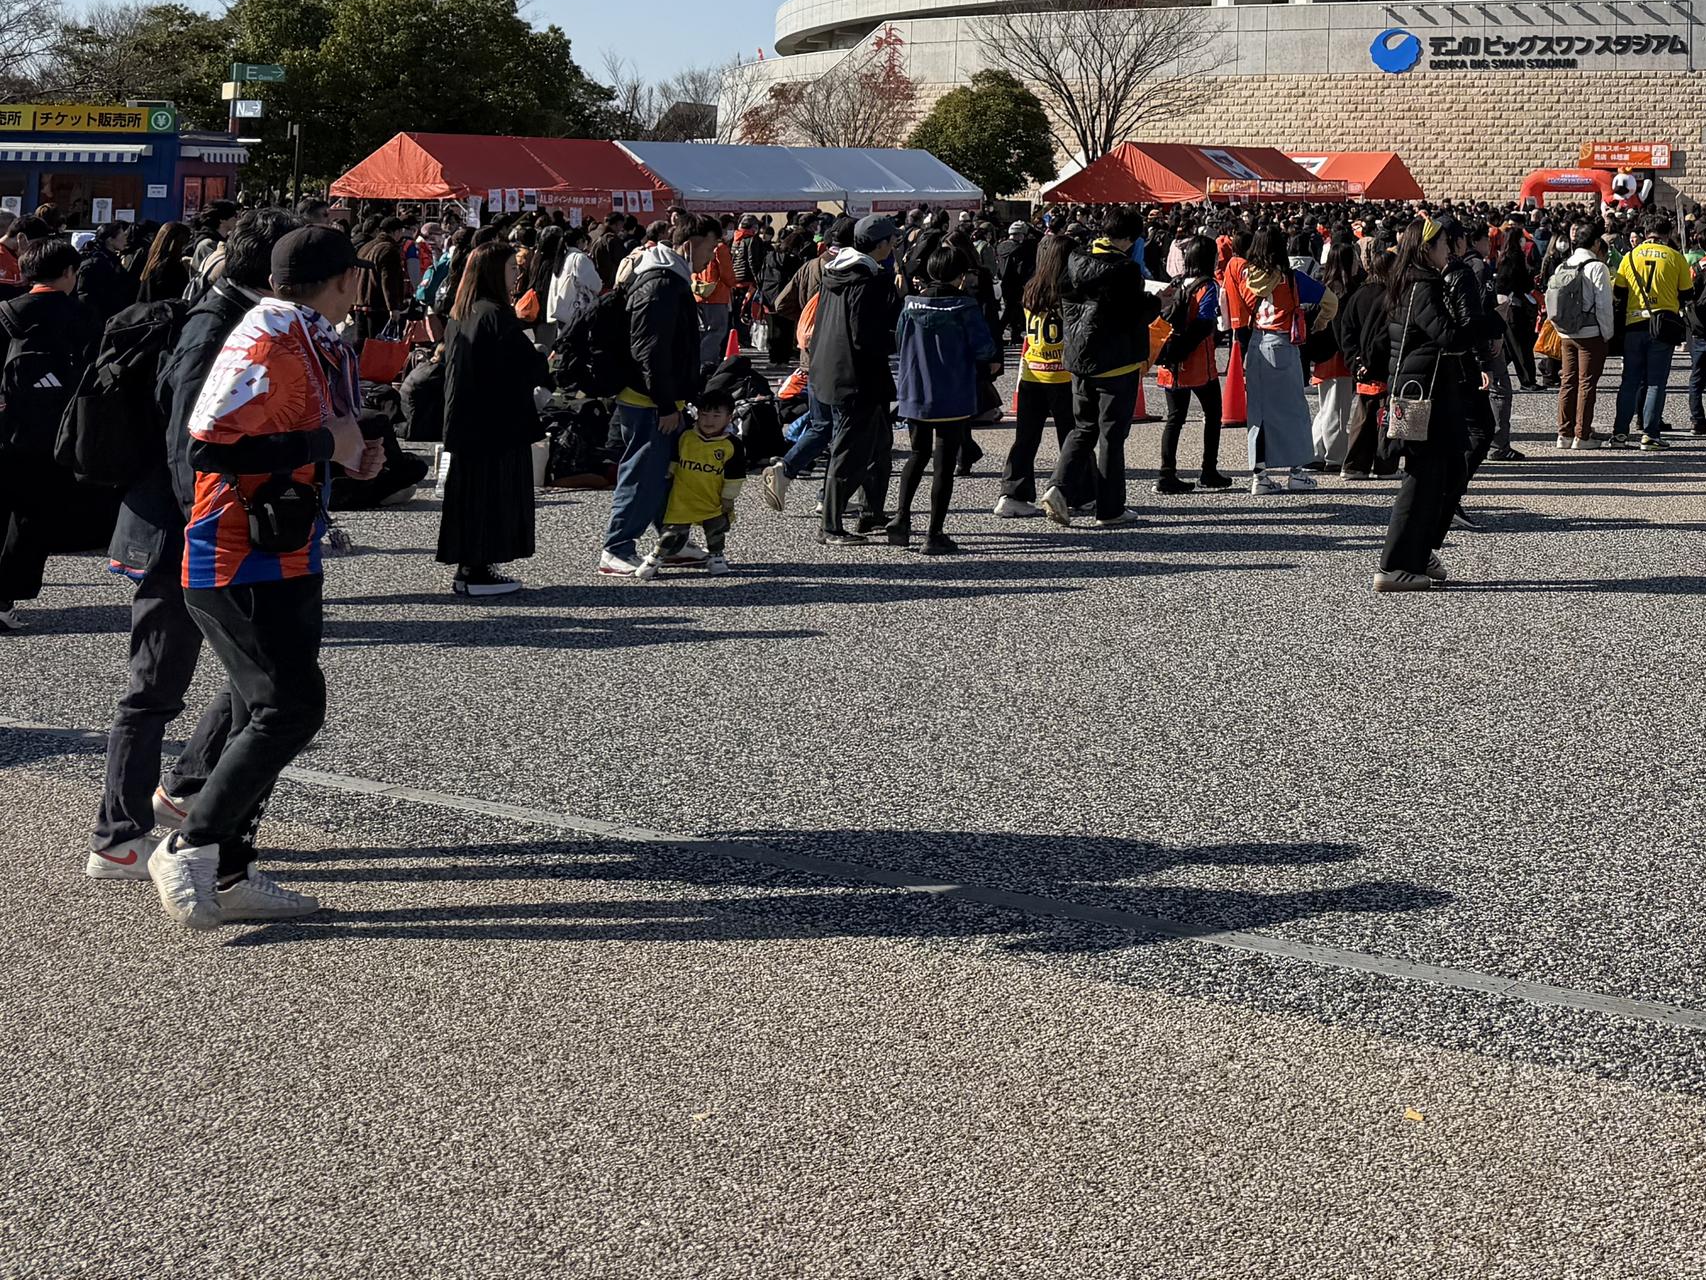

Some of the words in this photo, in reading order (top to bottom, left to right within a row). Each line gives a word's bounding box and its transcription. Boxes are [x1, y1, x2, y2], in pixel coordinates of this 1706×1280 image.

[1429, 59, 1468, 70] DENKA
[1470, 59, 1490, 70] BIG
[1491, 59, 1525, 70] SWAN
[1527, 59, 1578, 69] STADIUM
[40, 111, 142, 128] チケット販売所
[1644, 260, 1657, 294] 7
